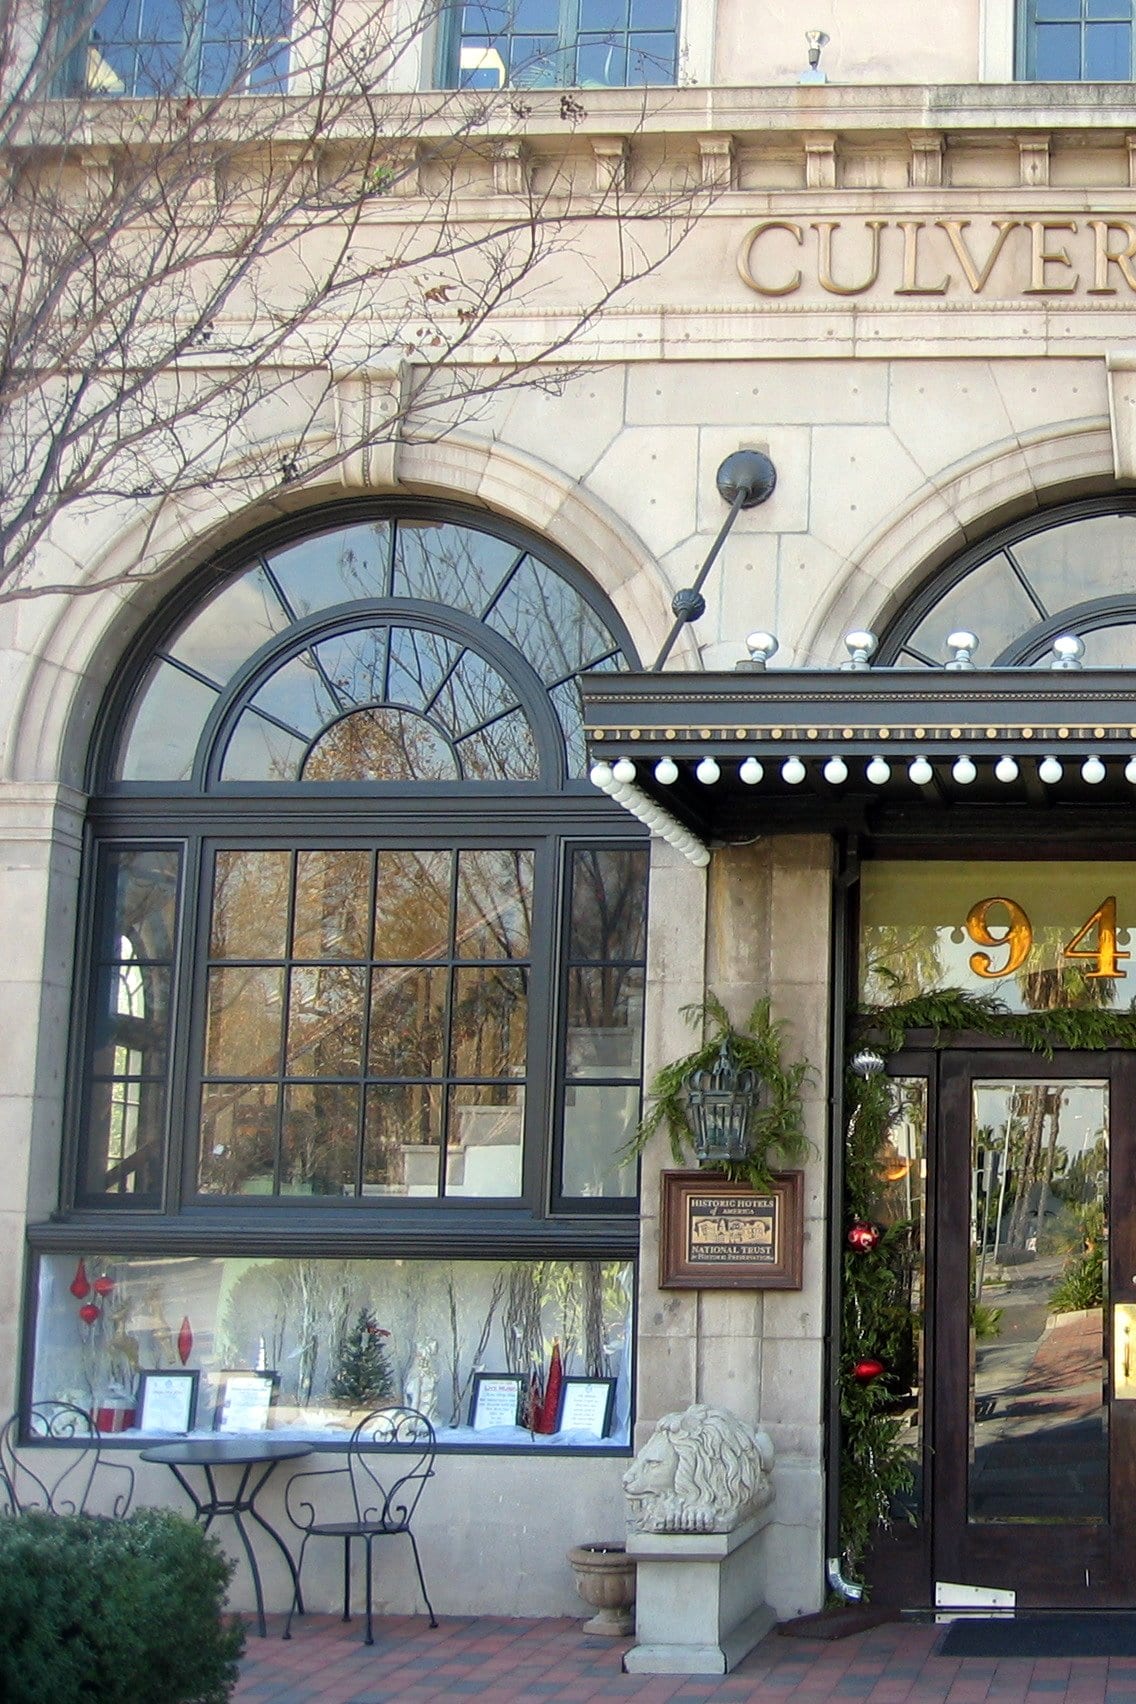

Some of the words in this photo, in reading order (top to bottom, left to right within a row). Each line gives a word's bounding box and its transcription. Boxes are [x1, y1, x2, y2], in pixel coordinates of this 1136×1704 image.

[691, 1199, 736, 1208] HISTORIC
[737, 1199, 774, 1208] HOTELS
[691, 1245, 739, 1254] NATIONAL
[741, 1245, 772, 1254] TRUST
